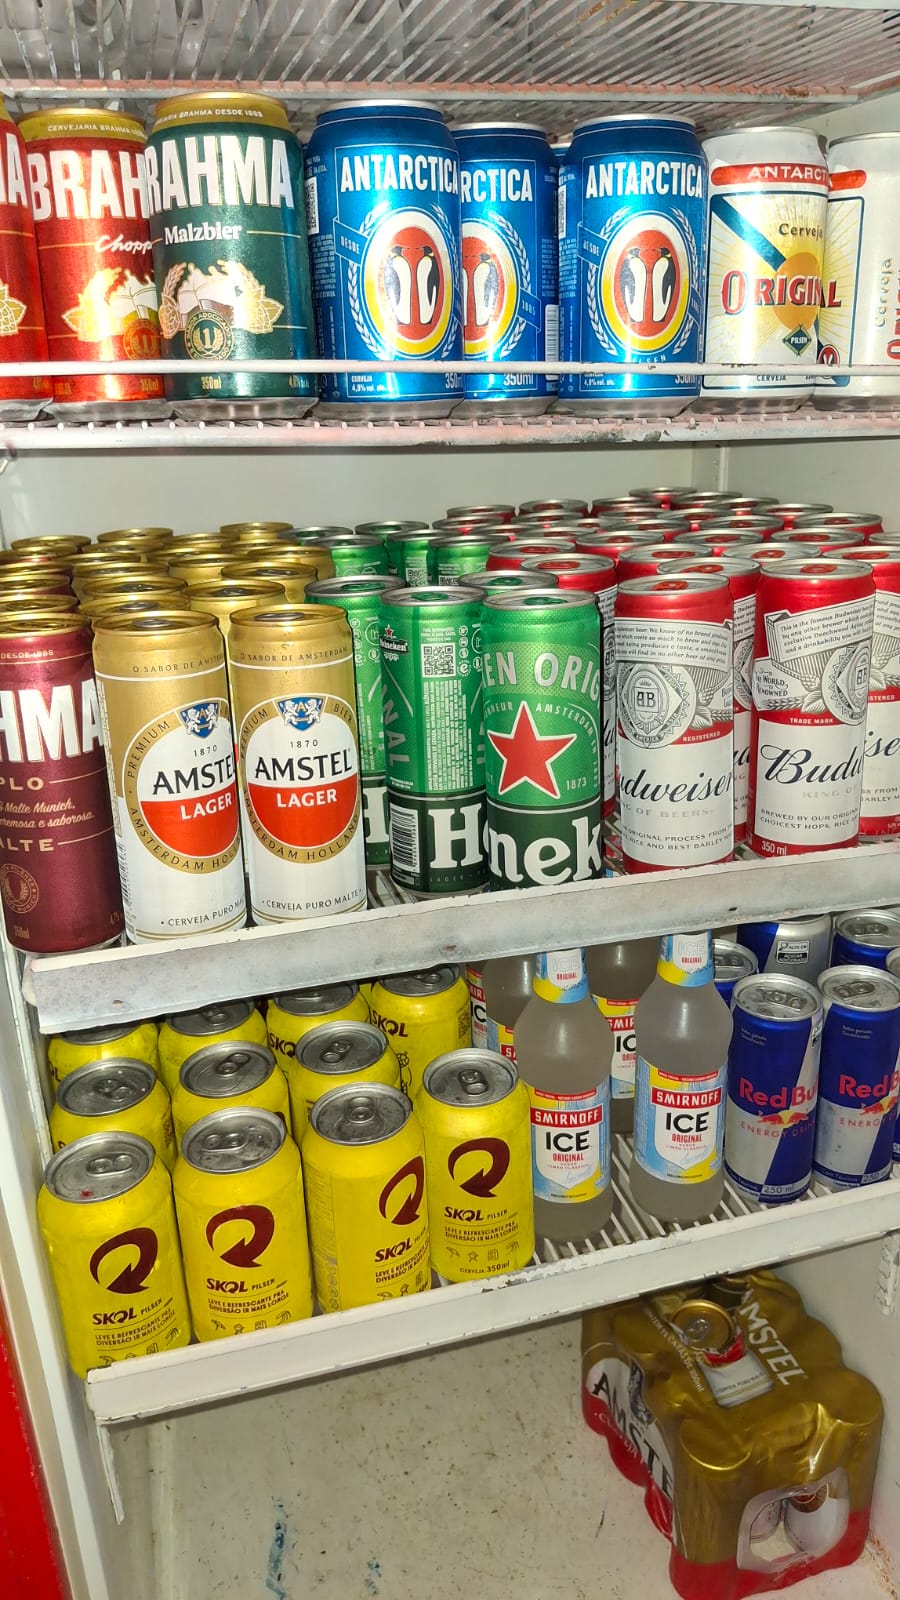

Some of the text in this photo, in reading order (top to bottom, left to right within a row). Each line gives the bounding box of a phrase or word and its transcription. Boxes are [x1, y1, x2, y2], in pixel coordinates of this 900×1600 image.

[179, 109, 212, 118] BRAHMA
[215, 109, 242, 117] DESDE
[48, 124, 98, 132] CERVEJARIA
[340, 154, 459, 195] ANTARCTICA
[585, 161, 703, 199] ANTARCTICA
[164, 222, 242, 245] Malzbier
[779, 223, 824, 241] Cerveja
[95, 235, 153, 254] Chopp
[790, 336, 808, 345] PILSEN
[503, 373, 534, 388] 350ml
[756, 374, 787, 382] CERVEJA
[799, 619, 809, 627] the
[803, 625, 820, 634] other
[822, 619, 843, 630] brewer
[248, 646, 348, 662] SABOR DE AMSTERDAM
[785, 646, 797, 654] and
[144, 664, 179, 672] SABOR
[183, 661, 195, 670] DE
[333, 703, 353, 724] BIER
[536, 702, 593, 737] AMSTERDAM
[790, 717, 812, 725] TRADE
[241, 708, 269, 760] PREMIUM
[683, 731, 721, 742] REGISTERED
[127, 720, 171, 778] PREMIUM
[193, 744, 218, 757] 1870
[290, 739, 318, 749] 1870
[255, 748, 352, 781] AMSTEL
[566, 777, 587, 790] 1873
[875, 786, 897, 794] FROM
[4, 798, 76, 814] Malte Munich.
[180, 792, 233, 821] LAGER
[276, 789, 337, 808] LAGER
[760, 807, 794, 821] BREWED
[243, 788, 298, 860] AMSTERDAM
[306, 812, 360, 861] HOLLAND
[760, 816, 801, 829] CHOICEST
[834, 818, 849, 828] RICE
[129, 807, 205, 871] AMSTERDAM
[665, 834, 706, 842] PROCESS
[694, 838, 723, 849] BARLEY
[761, 840, 787, 857] 350 ml
[267, 890, 359, 912] CERVEJA PURO MALTE
[168, 904, 234, 927] CERVEJA PURO
[556, 972, 577, 981] ORIGINAL
[372, 1010, 409, 1038] SKOL
[739, 1077, 787, 1108] Red
[839, 1074, 887, 1098] Red
[656, 1090, 719, 1106] SMIRNOFF
[535, 1109, 599, 1125] SMIRNOFF
[665, 1112, 709, 1134] ICE
[840, 1117, 886, 1128] ENERGY
[741, 1120, 788, 1138] ENERGY
[545, 1130, 590, 1153] ICE
[672, 1133, 703, 1143] ORIGINAL
[552, 1152, 584, 1162] ORIGINAL
[764, 1184, 795, 1193] 250 ml
[444, 1206, 508, 1221] SKOL PILSEN
[485, 1232, 499, 1241] MAIS
[375, 1238, 413, 1263] SKOL
[486, 1261, 511, 1273] 350ml
[206, 1277, 276, 1294] SKOL PILSEN
[92, 1298, 163, 1326] SKOL PILSEN
[251, 1305, 267, 1313] MAIS
[141, 1325, 157, 1338] MAIS
